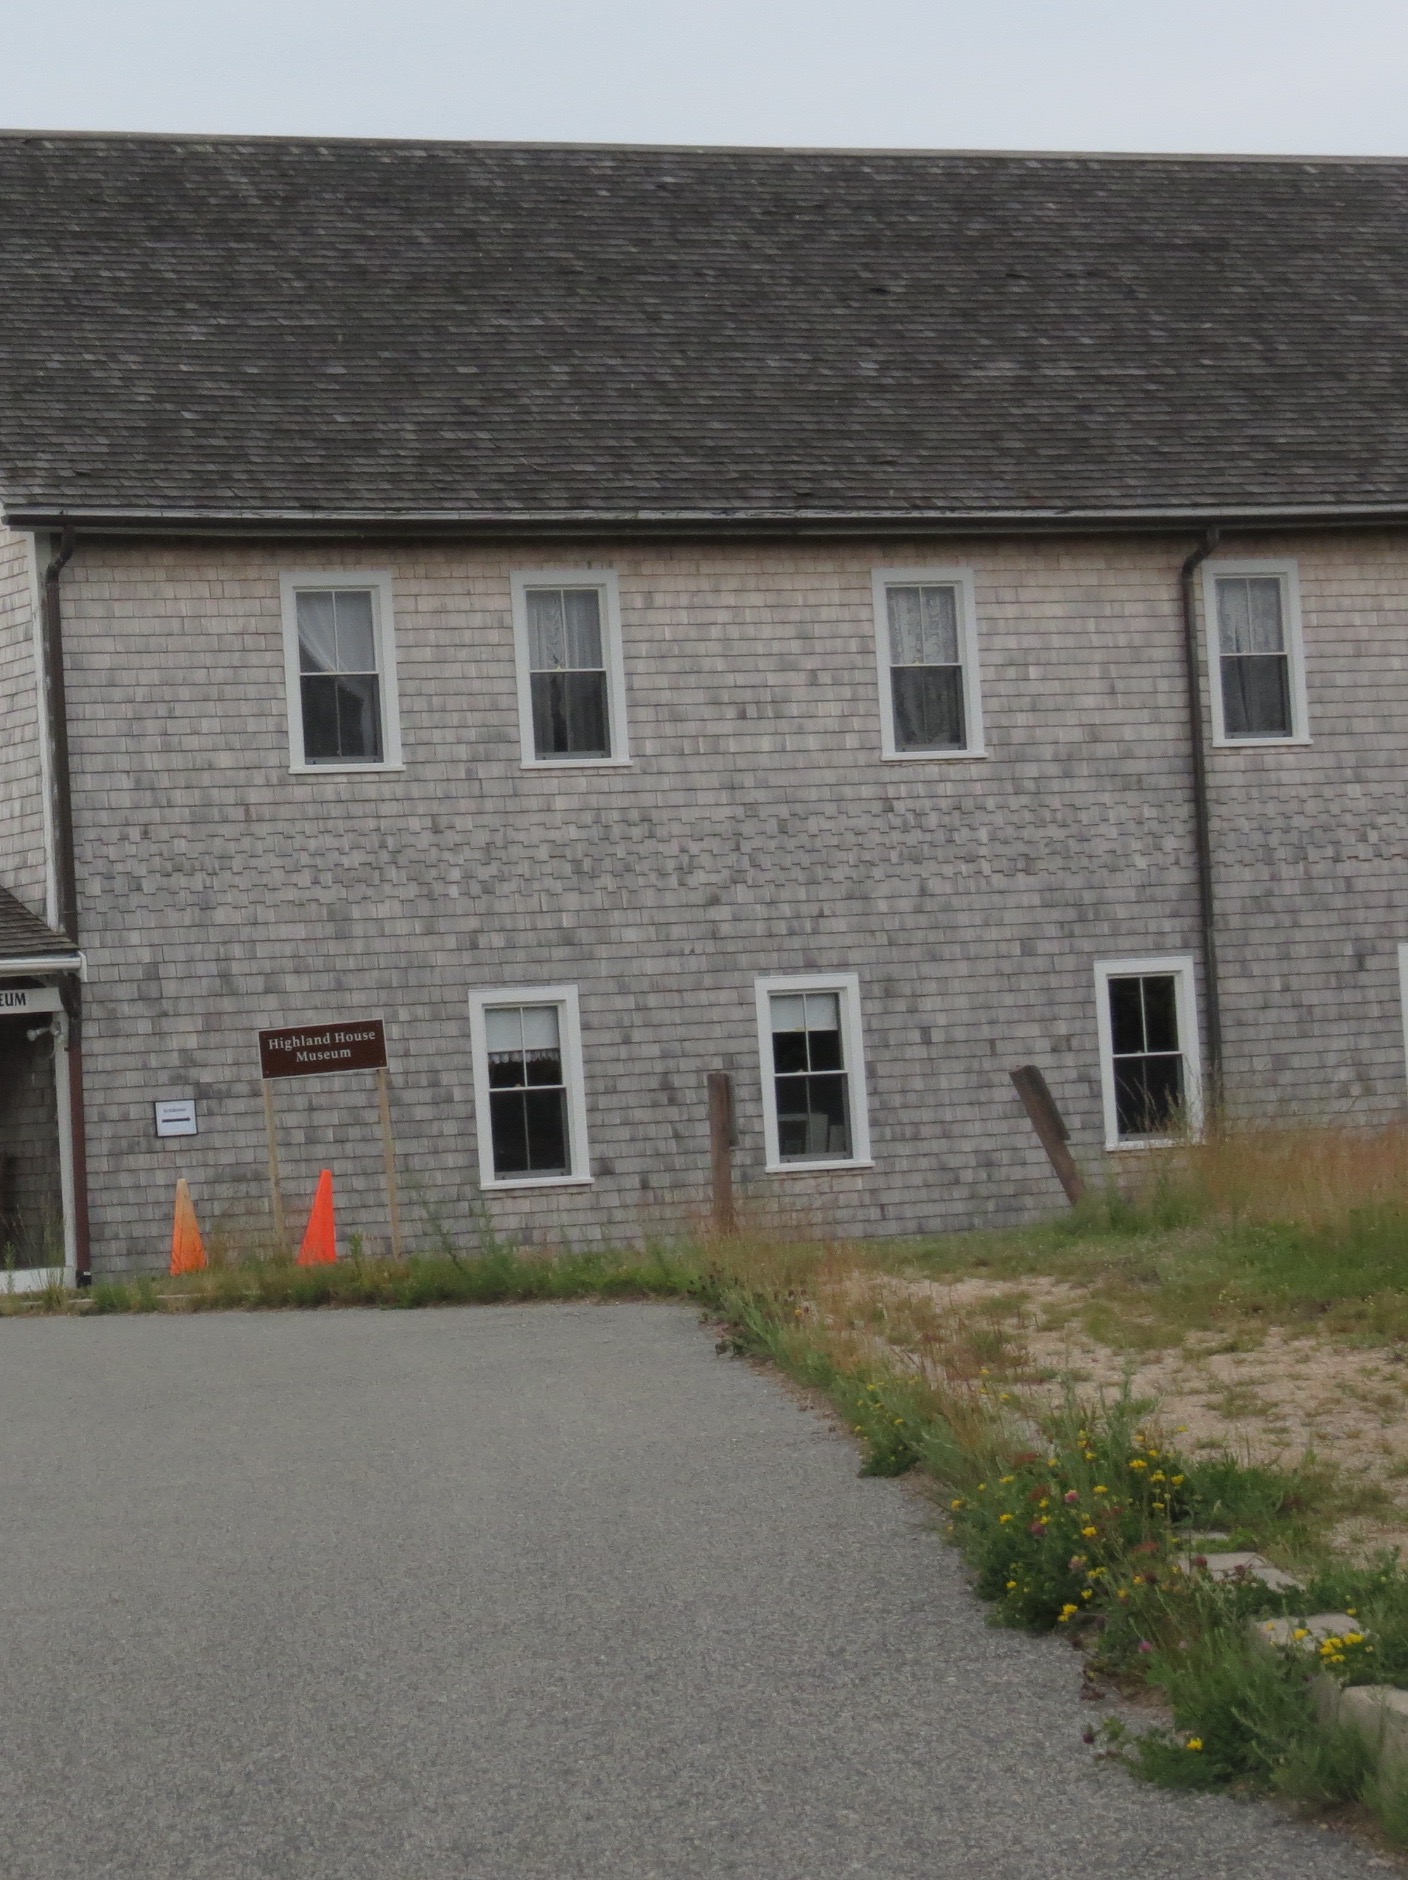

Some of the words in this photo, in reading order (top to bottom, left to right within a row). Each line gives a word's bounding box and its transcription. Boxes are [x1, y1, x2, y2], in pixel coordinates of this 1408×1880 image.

[268, 1032, 331, 1051] Highland
[334, 1031, 376, 1043] House
[296, 1049, 352, 1062] Museum
